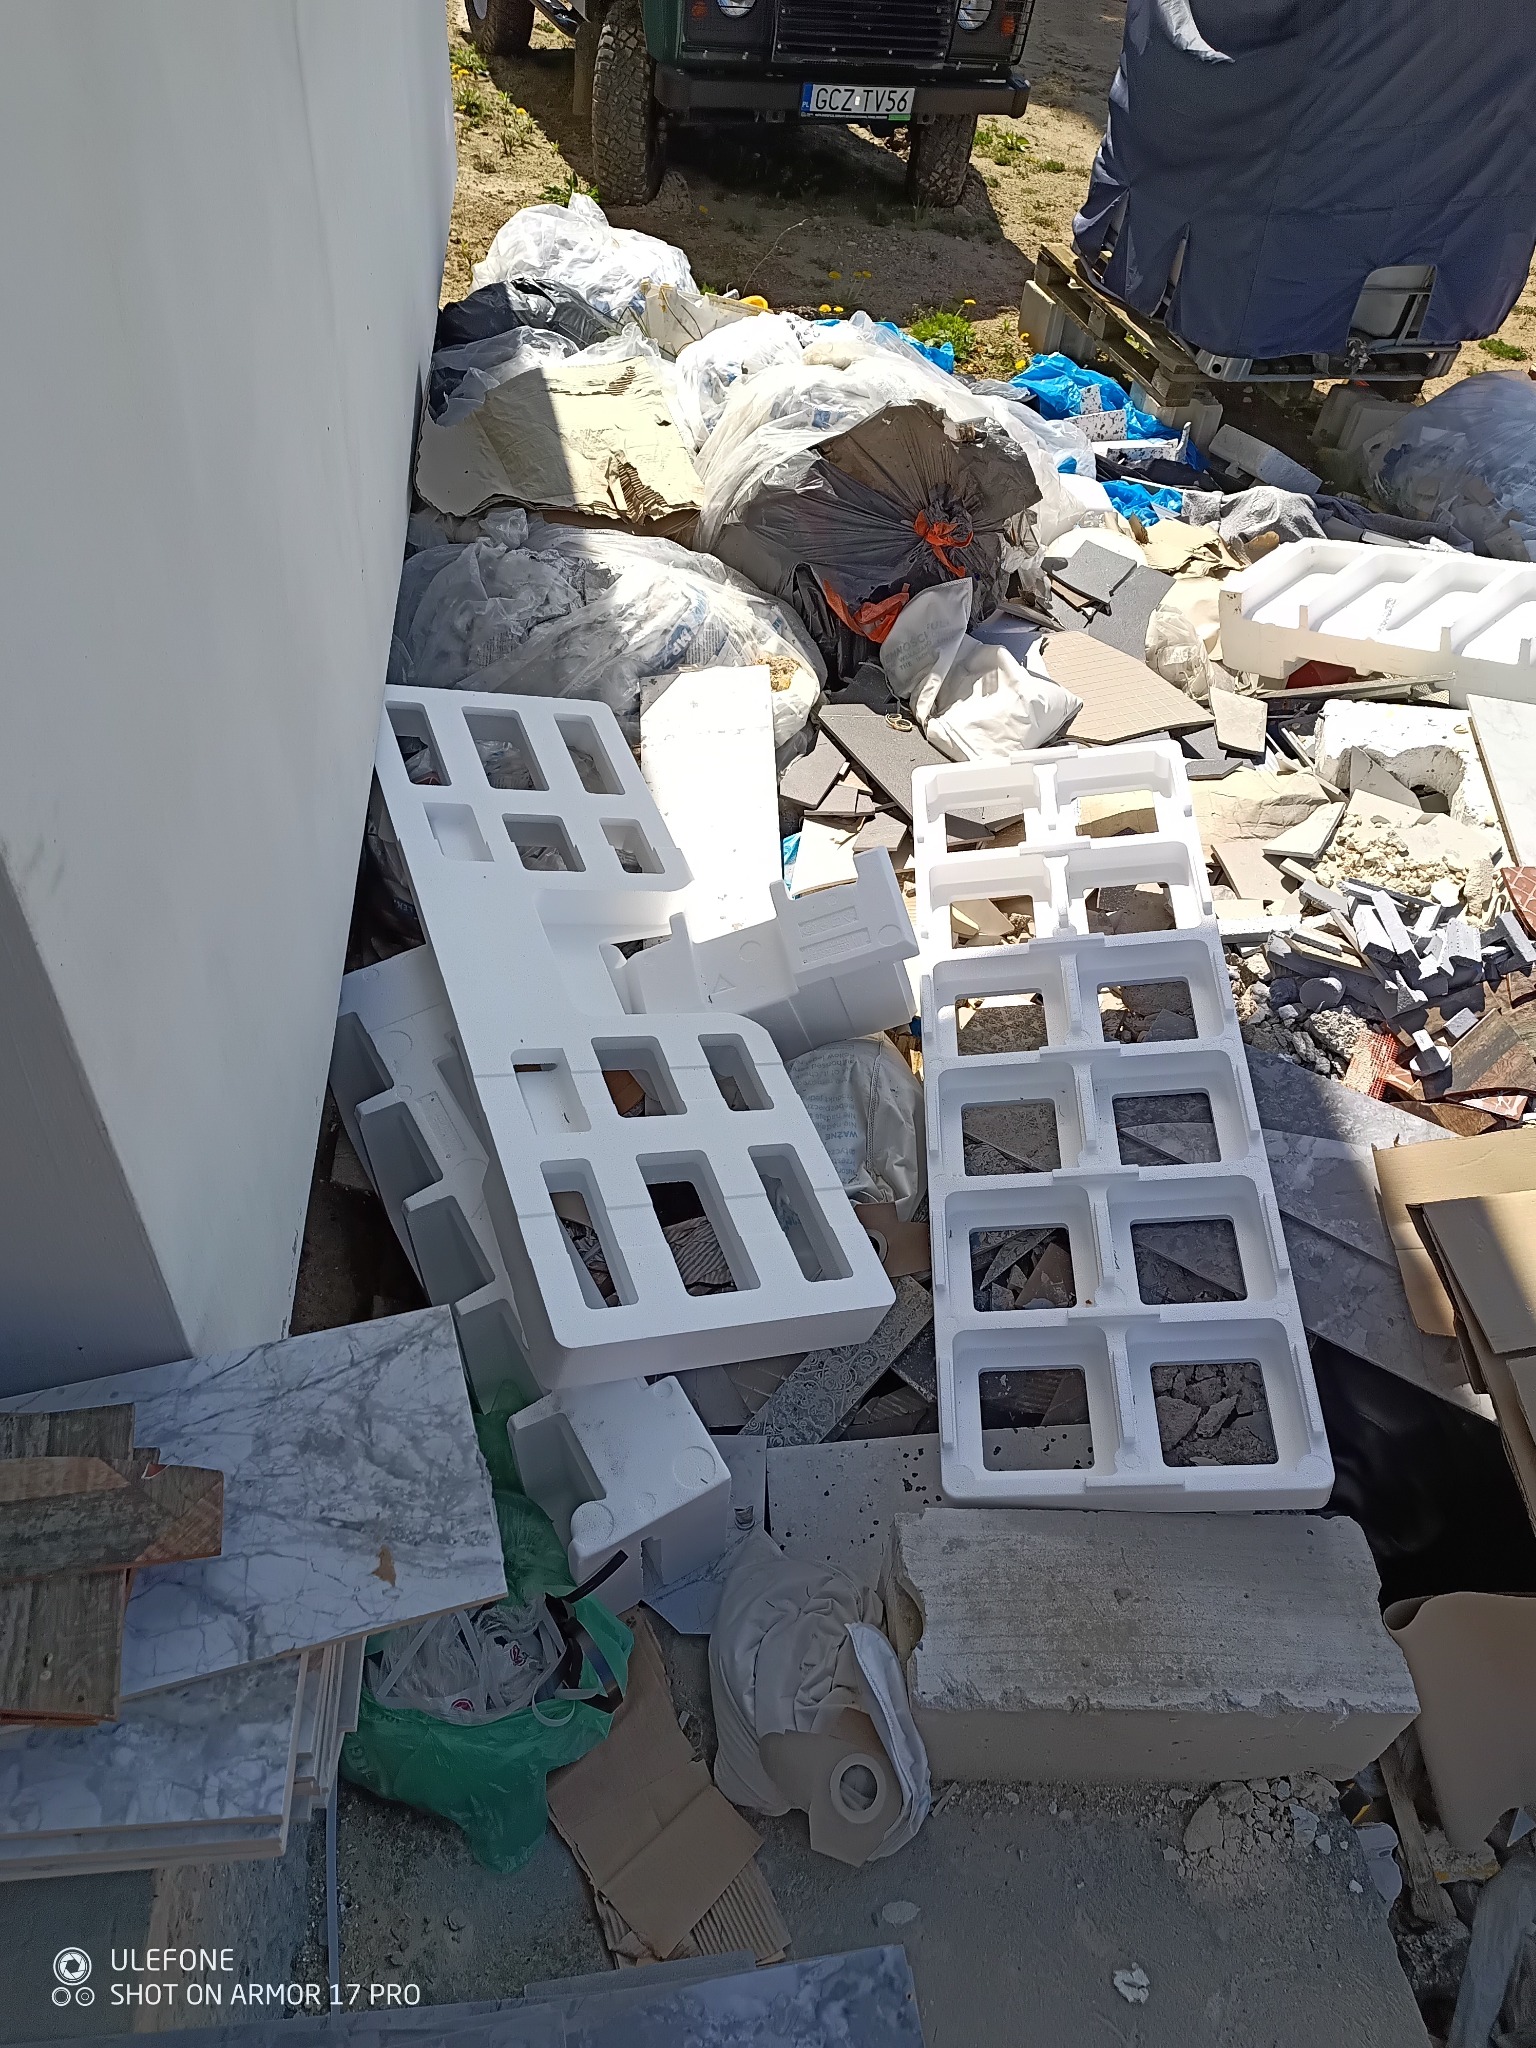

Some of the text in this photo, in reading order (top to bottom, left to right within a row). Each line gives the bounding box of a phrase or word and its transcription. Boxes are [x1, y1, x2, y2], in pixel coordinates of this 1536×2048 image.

[815, 88, 910, 112] GCZ TV56
[825, 1131, 858, 1140] WAŻNE
